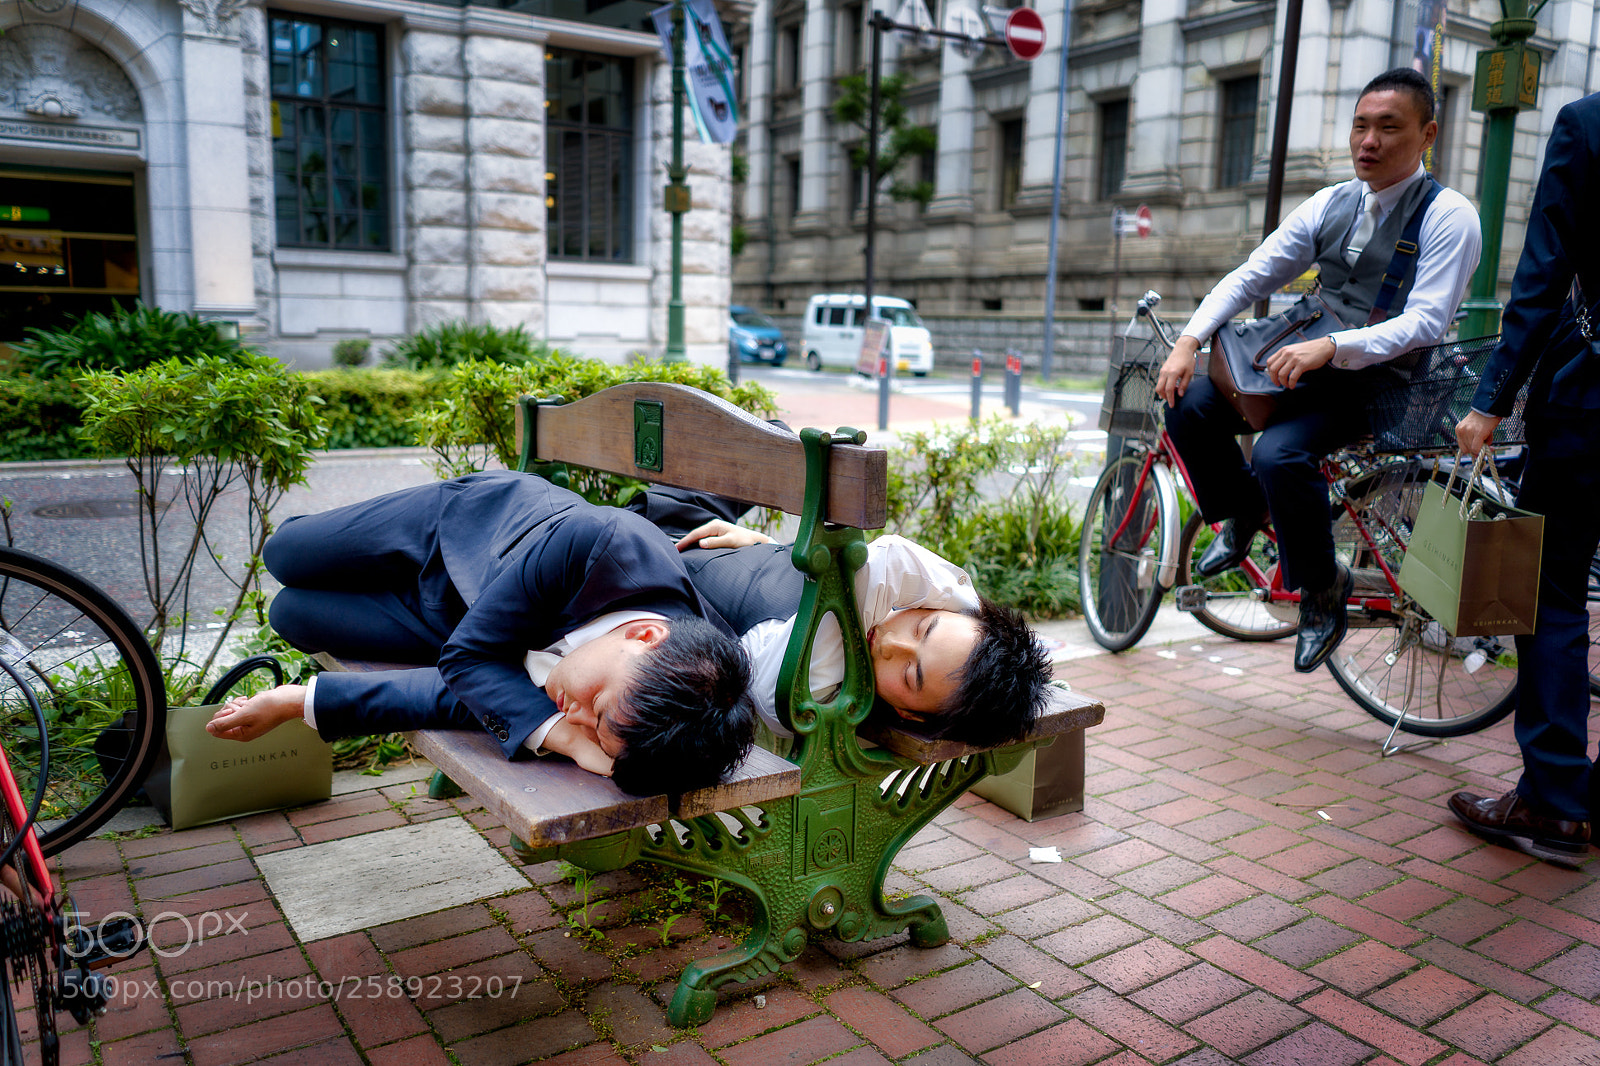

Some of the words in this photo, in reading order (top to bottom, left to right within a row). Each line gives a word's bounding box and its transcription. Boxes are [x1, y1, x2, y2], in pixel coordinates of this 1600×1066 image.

[1487, 51, 1505, 104] 馬車道
[1473, 619, 1518, 627] GEIHINKAN
[210, 749, 298, 770] GEIHINKAN
